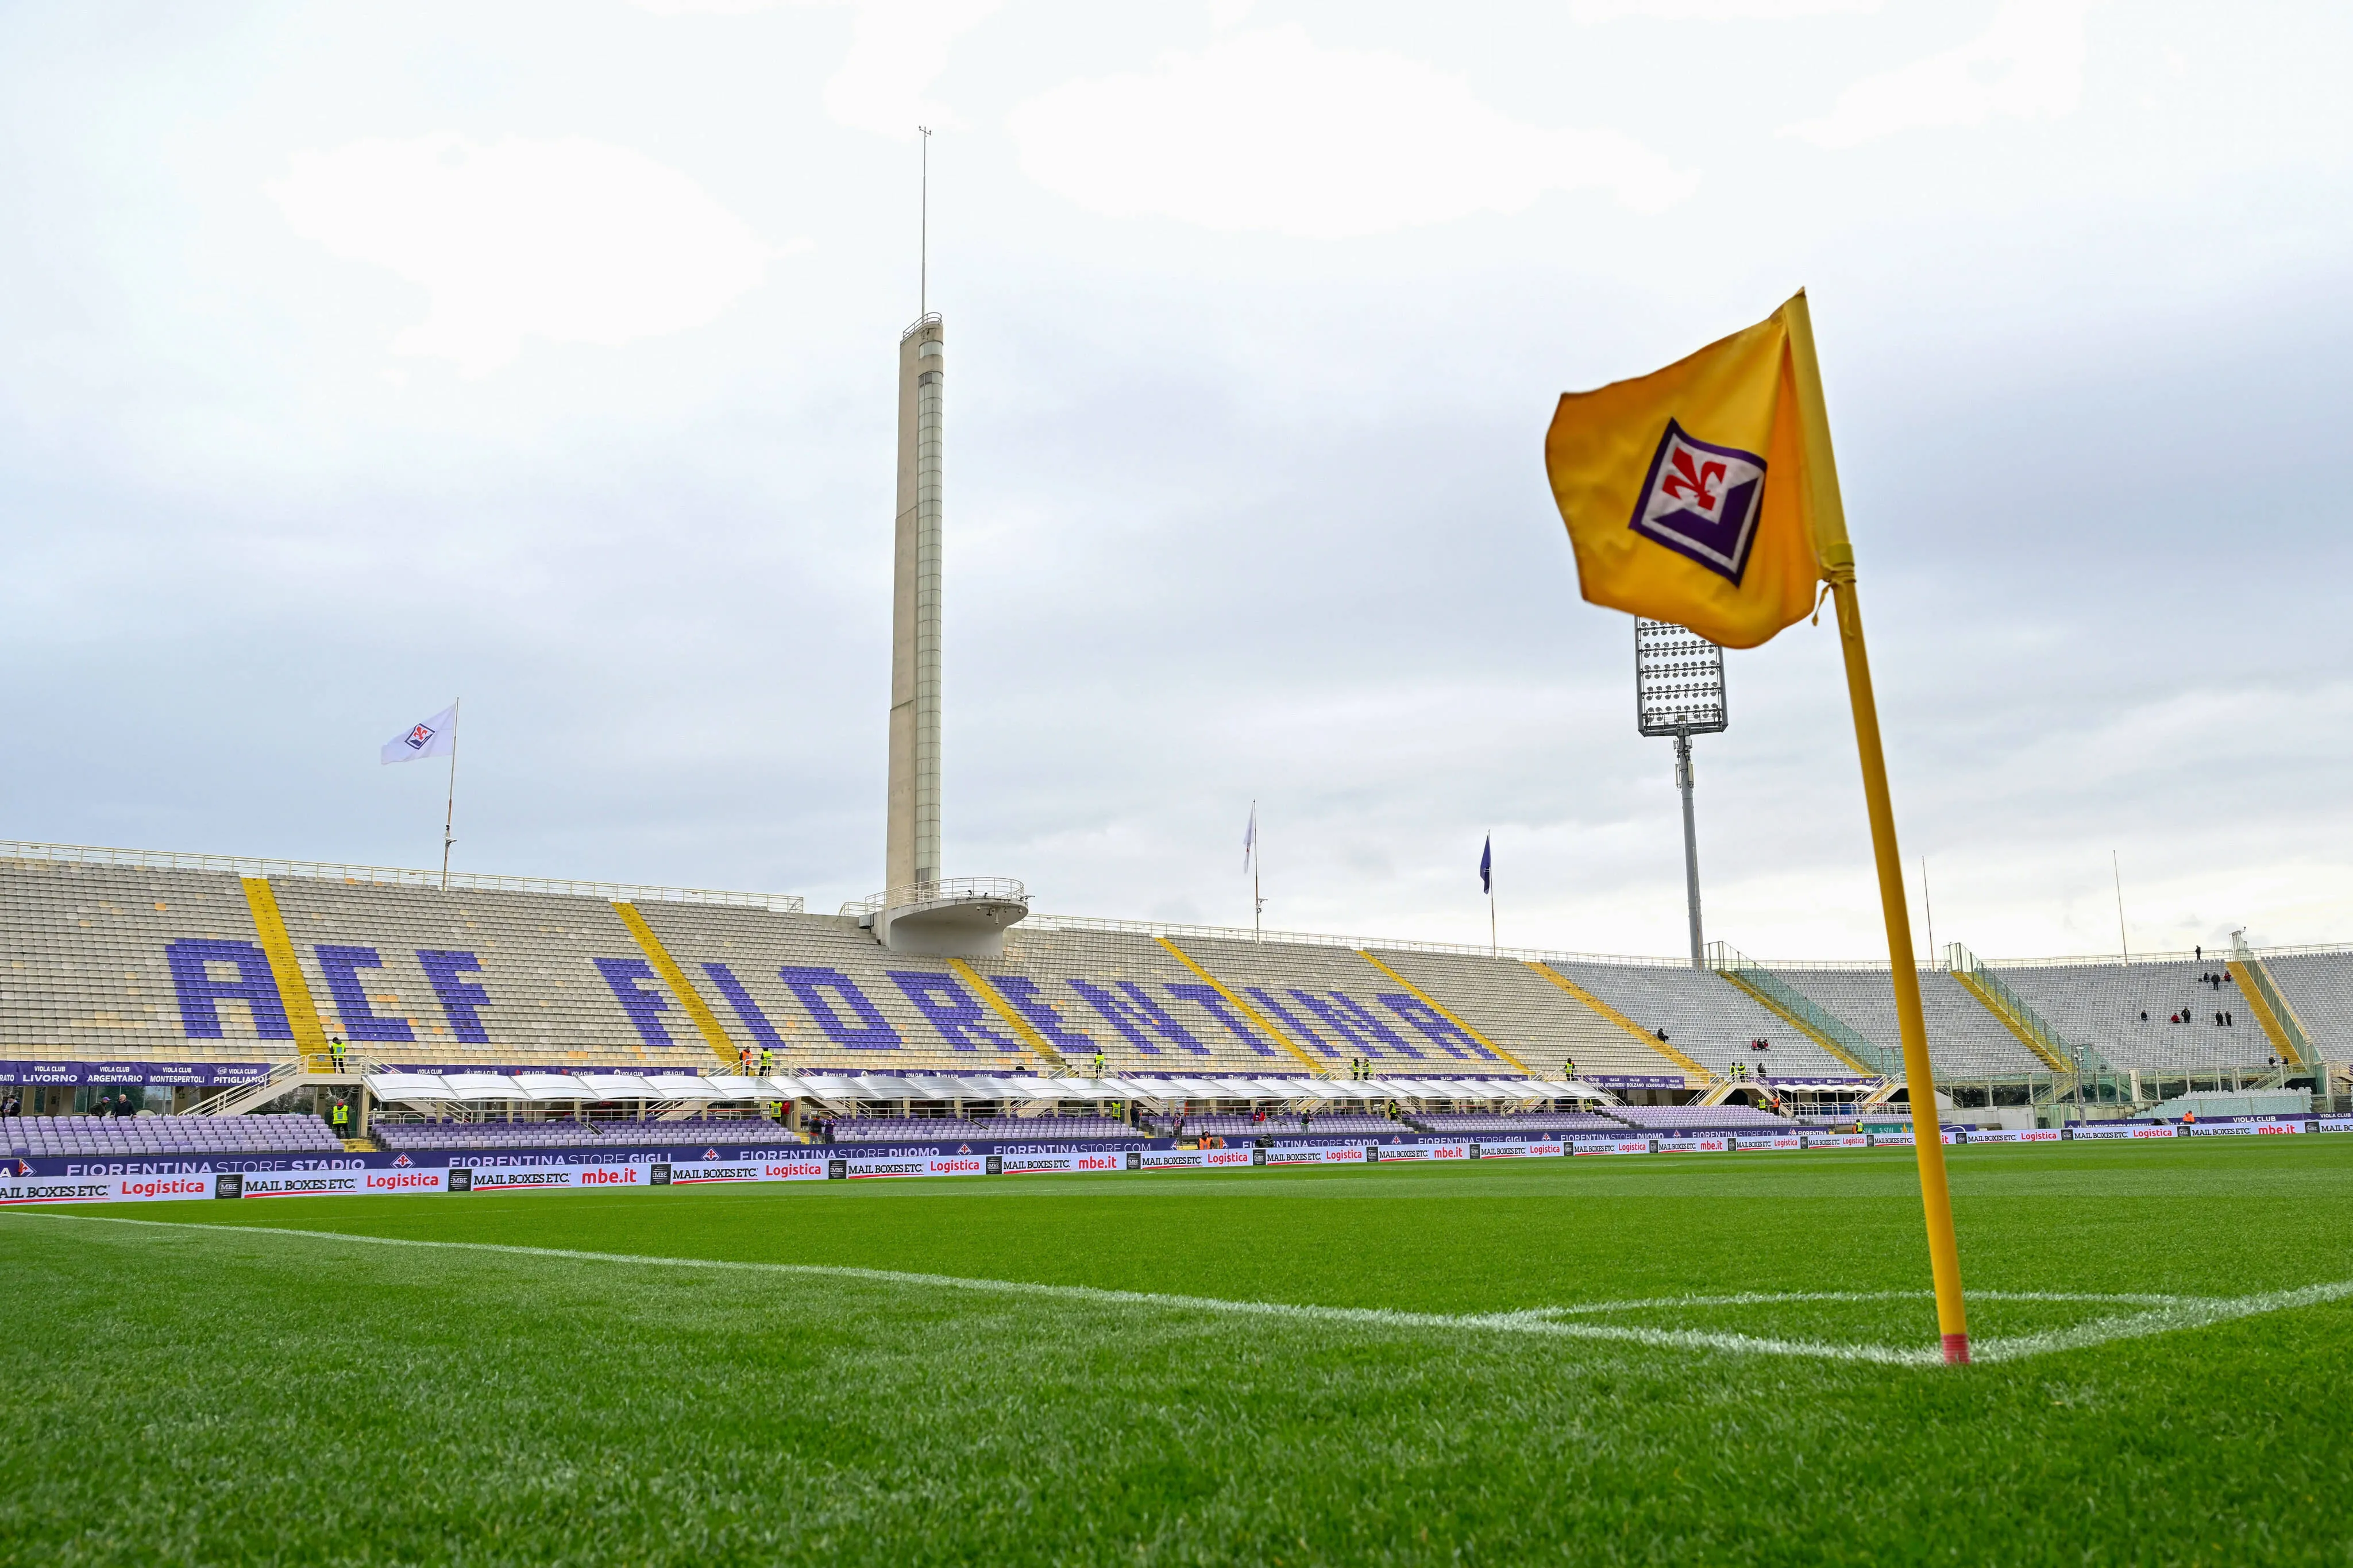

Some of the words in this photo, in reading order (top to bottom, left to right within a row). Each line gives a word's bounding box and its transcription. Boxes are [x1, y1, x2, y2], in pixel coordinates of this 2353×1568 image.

[165, 938, 490, 1042] ACF
[592, 957, 1498, 1060] FIORENTINA
[2133, 1129, 2172, 1138] Logistica
[2258, 1124, 2296, 1134] mbe.it
[1843, 1137, 1864, 1145] Logistica
[2022, 1131, 2057, 1141] Logistica
[1530, 1144, 1560, 1154] Logistica
[1618, 1142, 1646, 1153] Logistica
[1700, 1140, 1723, 1150] mbe.it
[1774, 1139, 1797, 1148] Logistica
[889, 1148, 940, 1157] DUOMO
[1326, 1149, 1362, 1161] Logistica
[1434, 1146, 1463, 1158] mbe.it
[629, 1153, 671, 1163] GIGLI
[1079, 1155, 1117, 1169] mbe.it
[1142, 1157, 1162, 1165] MAIL
[1163, 1157, 1187, 1165] BOXES
[1208, 1152, 1248, 1165] Logistica
[291, 1159, 365, 1171] STADIO
[766, 1163, 821, 1177] Logistica
[848, 1165, 874, 1174] MAIL
[875, 1164, 904, 1173] BOXES
[904, 1164, 923, 1172] ETC.
[931, 1160, 979, 1173] Logistica
[1004, 1161, 1027, 1169] MAIL
[1027, 1160, 1053, 1169] BOXES
[1054, 1160, 1071, 1168] ETC.
[474, 1175, 506, 1185] MAIL
[508, 1174, 545, 1184] BOXES
[546, 1173, 570, 1183] ETC.
[582, 1168, 637, 1184] mbe.it
[673, 1169, 701, 1179] MAIL
[704, 1168, 736, 1178] BOXES
[737, 1168, 758, 1176] ETC.
[245, 1181, 283, 1192] MAIL
[284, 1179, 326, 1190] BOXES
[329, 1179, 355, 1189] ETC.
[367, 1173, 439, 1190] Logistica
[26, 1185, 75, 1198] BOXES
[77, 1185, 108, 1196] ETC.
[122, 1179, 205, 1198] Logistica
